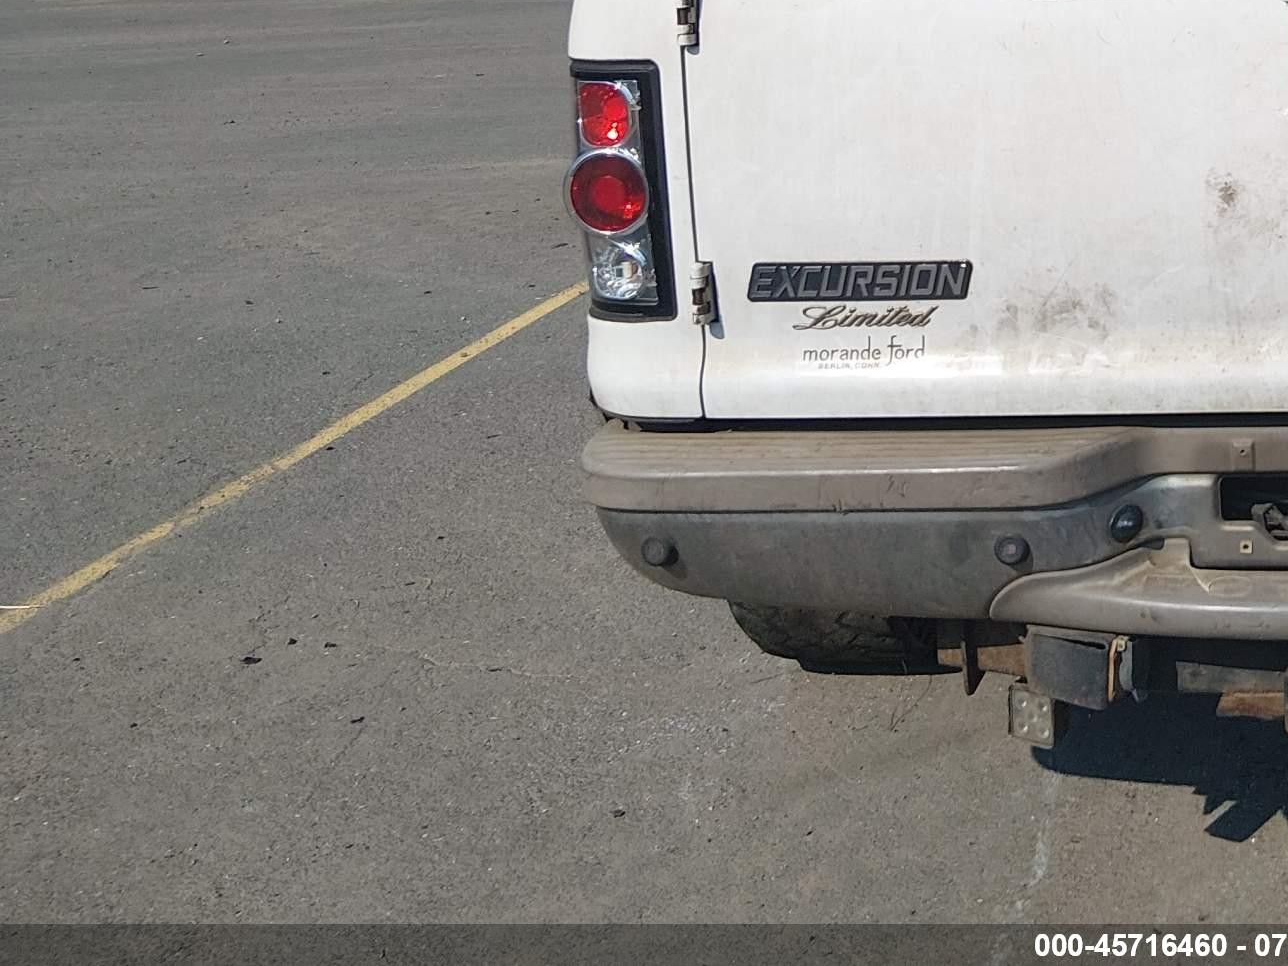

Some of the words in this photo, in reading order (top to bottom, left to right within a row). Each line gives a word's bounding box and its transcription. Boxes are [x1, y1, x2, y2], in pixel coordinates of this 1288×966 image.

[750, 264, 967, 298] EXCURSION
[792, 304, 939, 331] Limited
[803, 335, 881, 362] morande
[885, 335, 925, 367] ford
